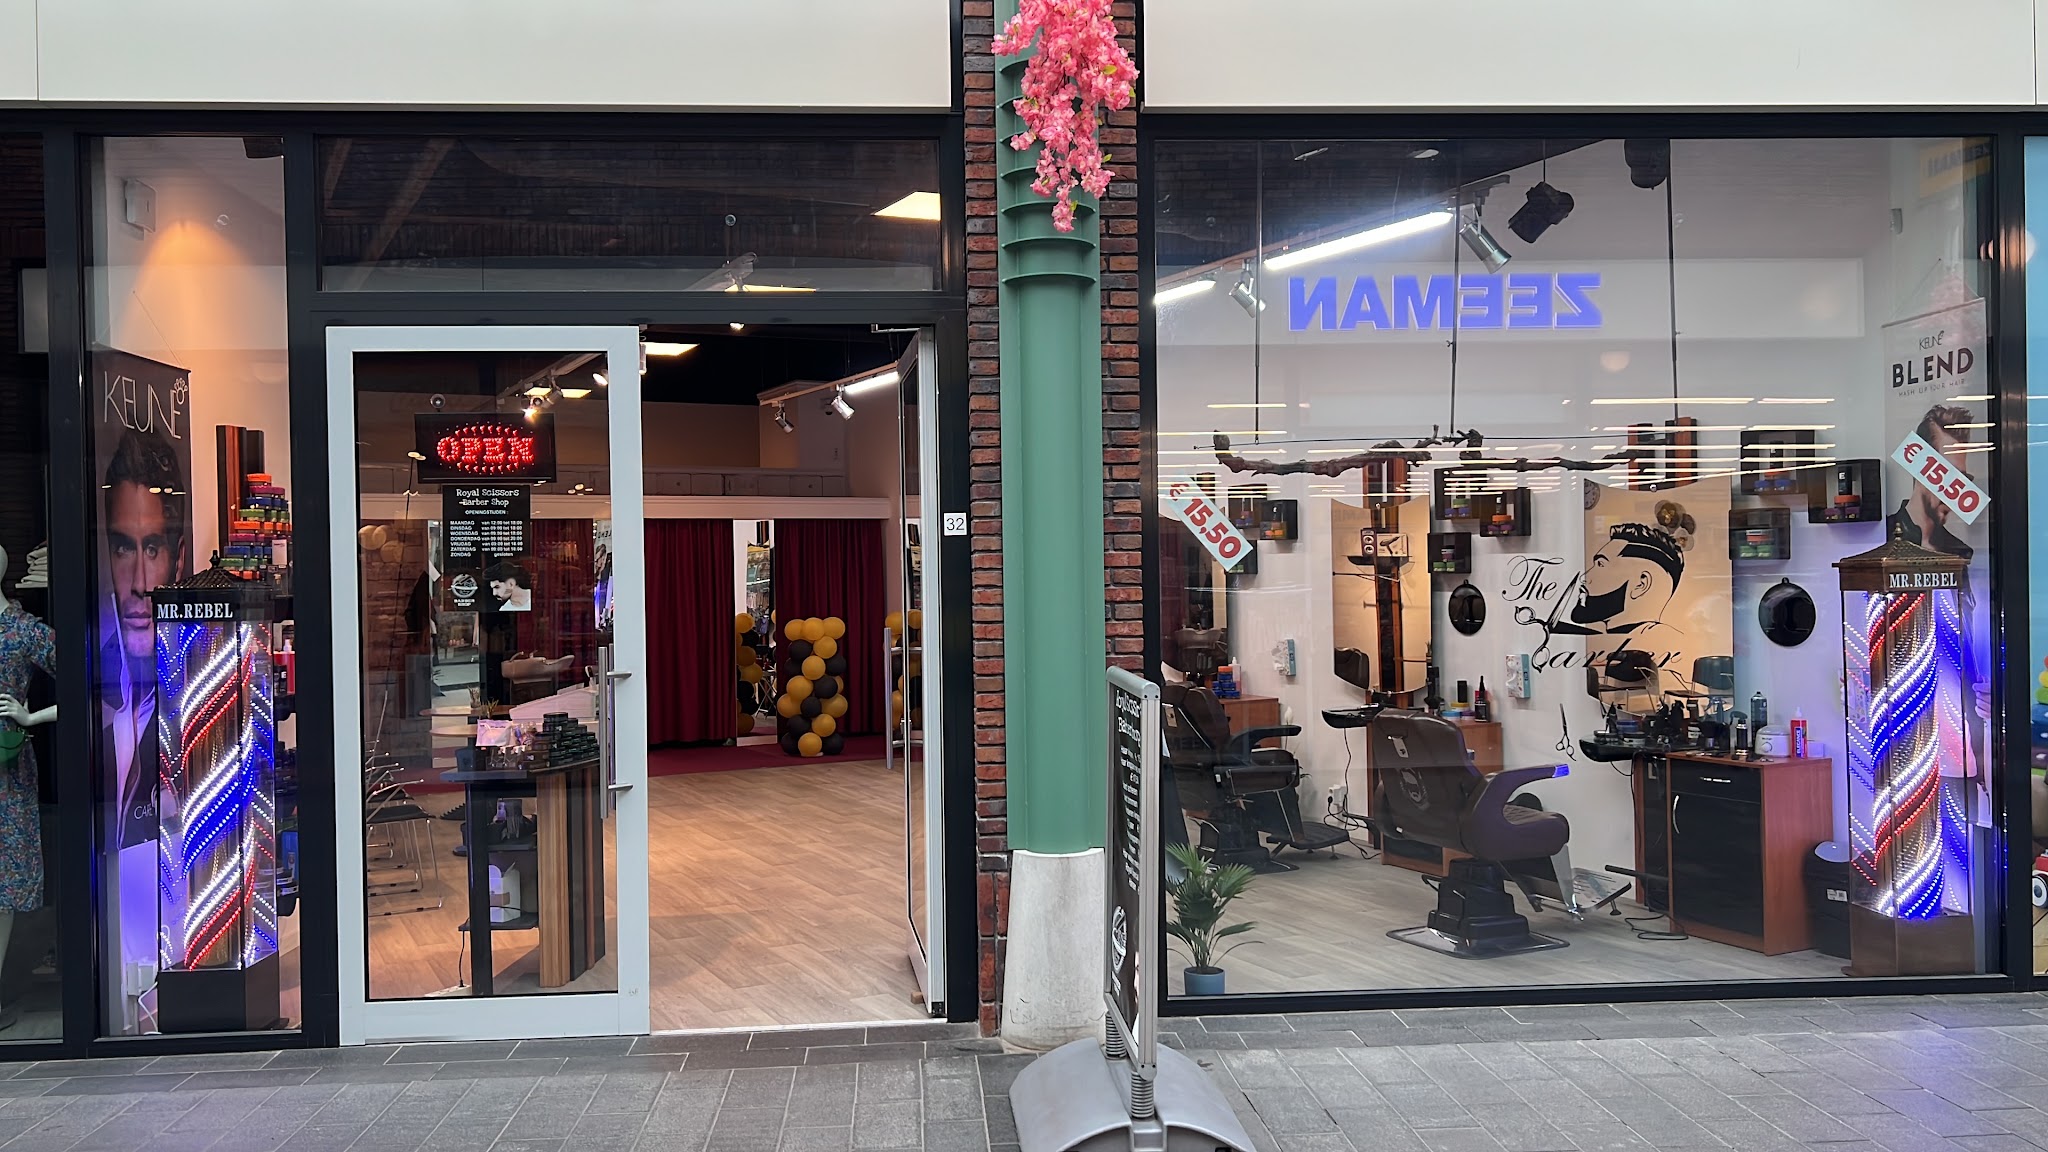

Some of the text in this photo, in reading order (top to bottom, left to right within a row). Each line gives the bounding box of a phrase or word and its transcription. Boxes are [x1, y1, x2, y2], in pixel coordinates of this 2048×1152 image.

[1892, 347, 1974, 388] BLEND
[104, 371, 188, 439] KEUNE
[437, 437, 534, 462] OPEN
[1903, 442, 1980, 513] € 15,50
[456, 488, 520, 498] Royal Scissors
[462, 498, 510, 508] Barber Shop
[946, 517, 965, 531] 32
[1183, 497, 1241, 559] 15,50
[1502, 555, 1564, 601] The
[1889, 572, 1957, 588] MR.REBEL
[157, 603, 233, 619] MR.REBEL
